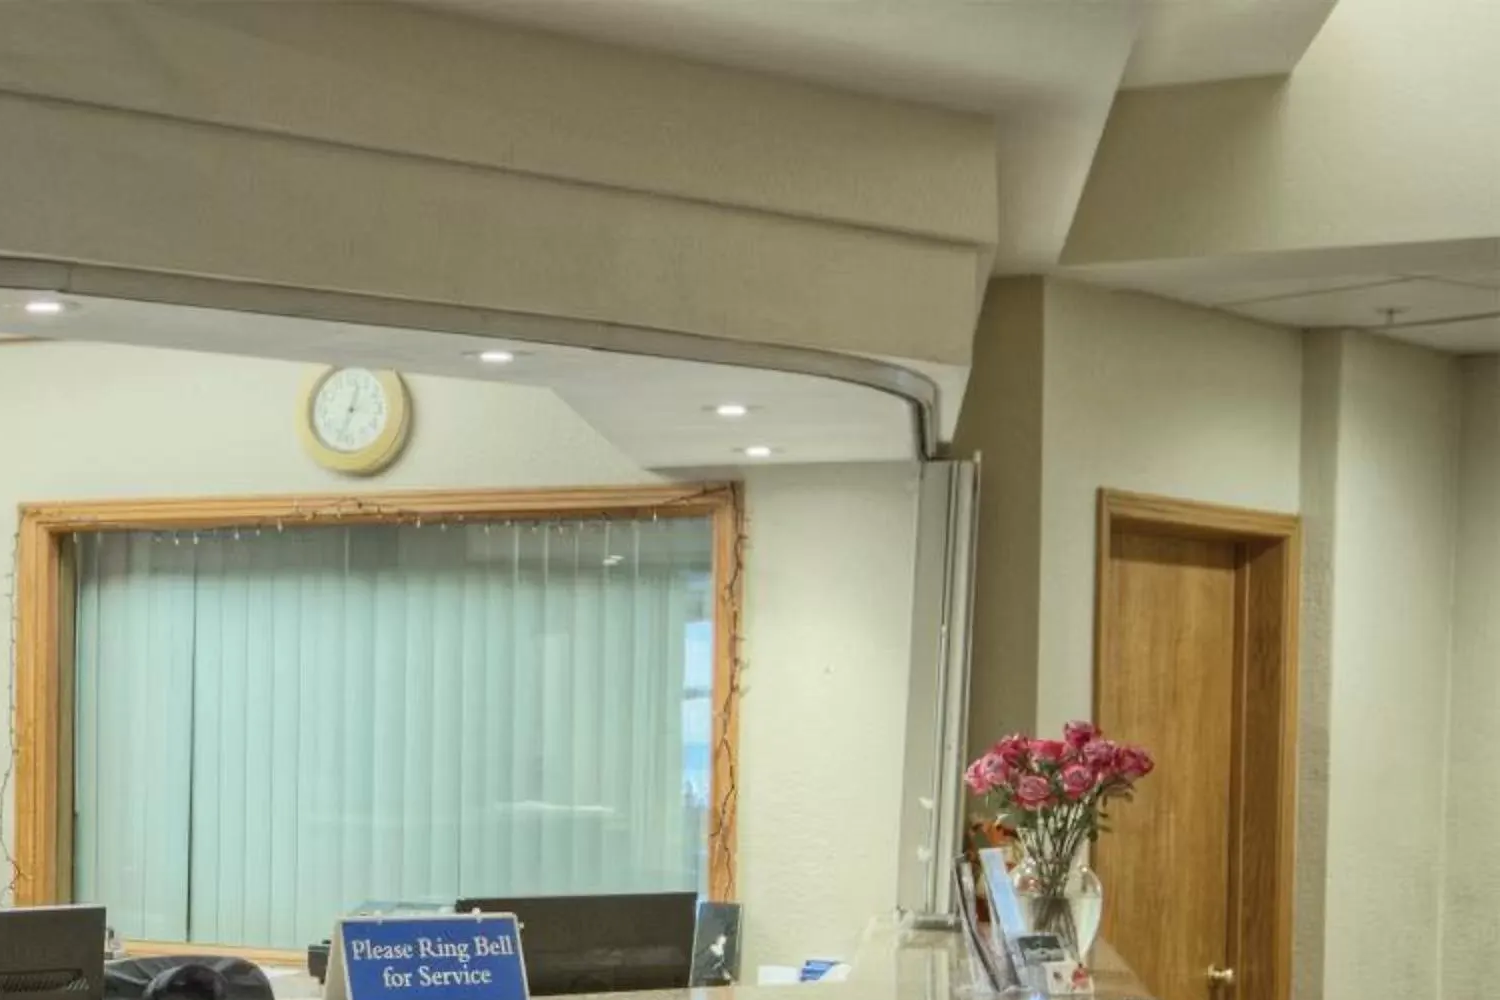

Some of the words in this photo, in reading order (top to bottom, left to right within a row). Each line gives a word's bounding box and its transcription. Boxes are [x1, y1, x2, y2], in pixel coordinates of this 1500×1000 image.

[352, 939, 414, 961] Please
[417, 935, 469, 963] Ring
[473, 935, 515, 957] Bell
[382, 965, 412, 988] for
[419, 964, 493, 987] Service
